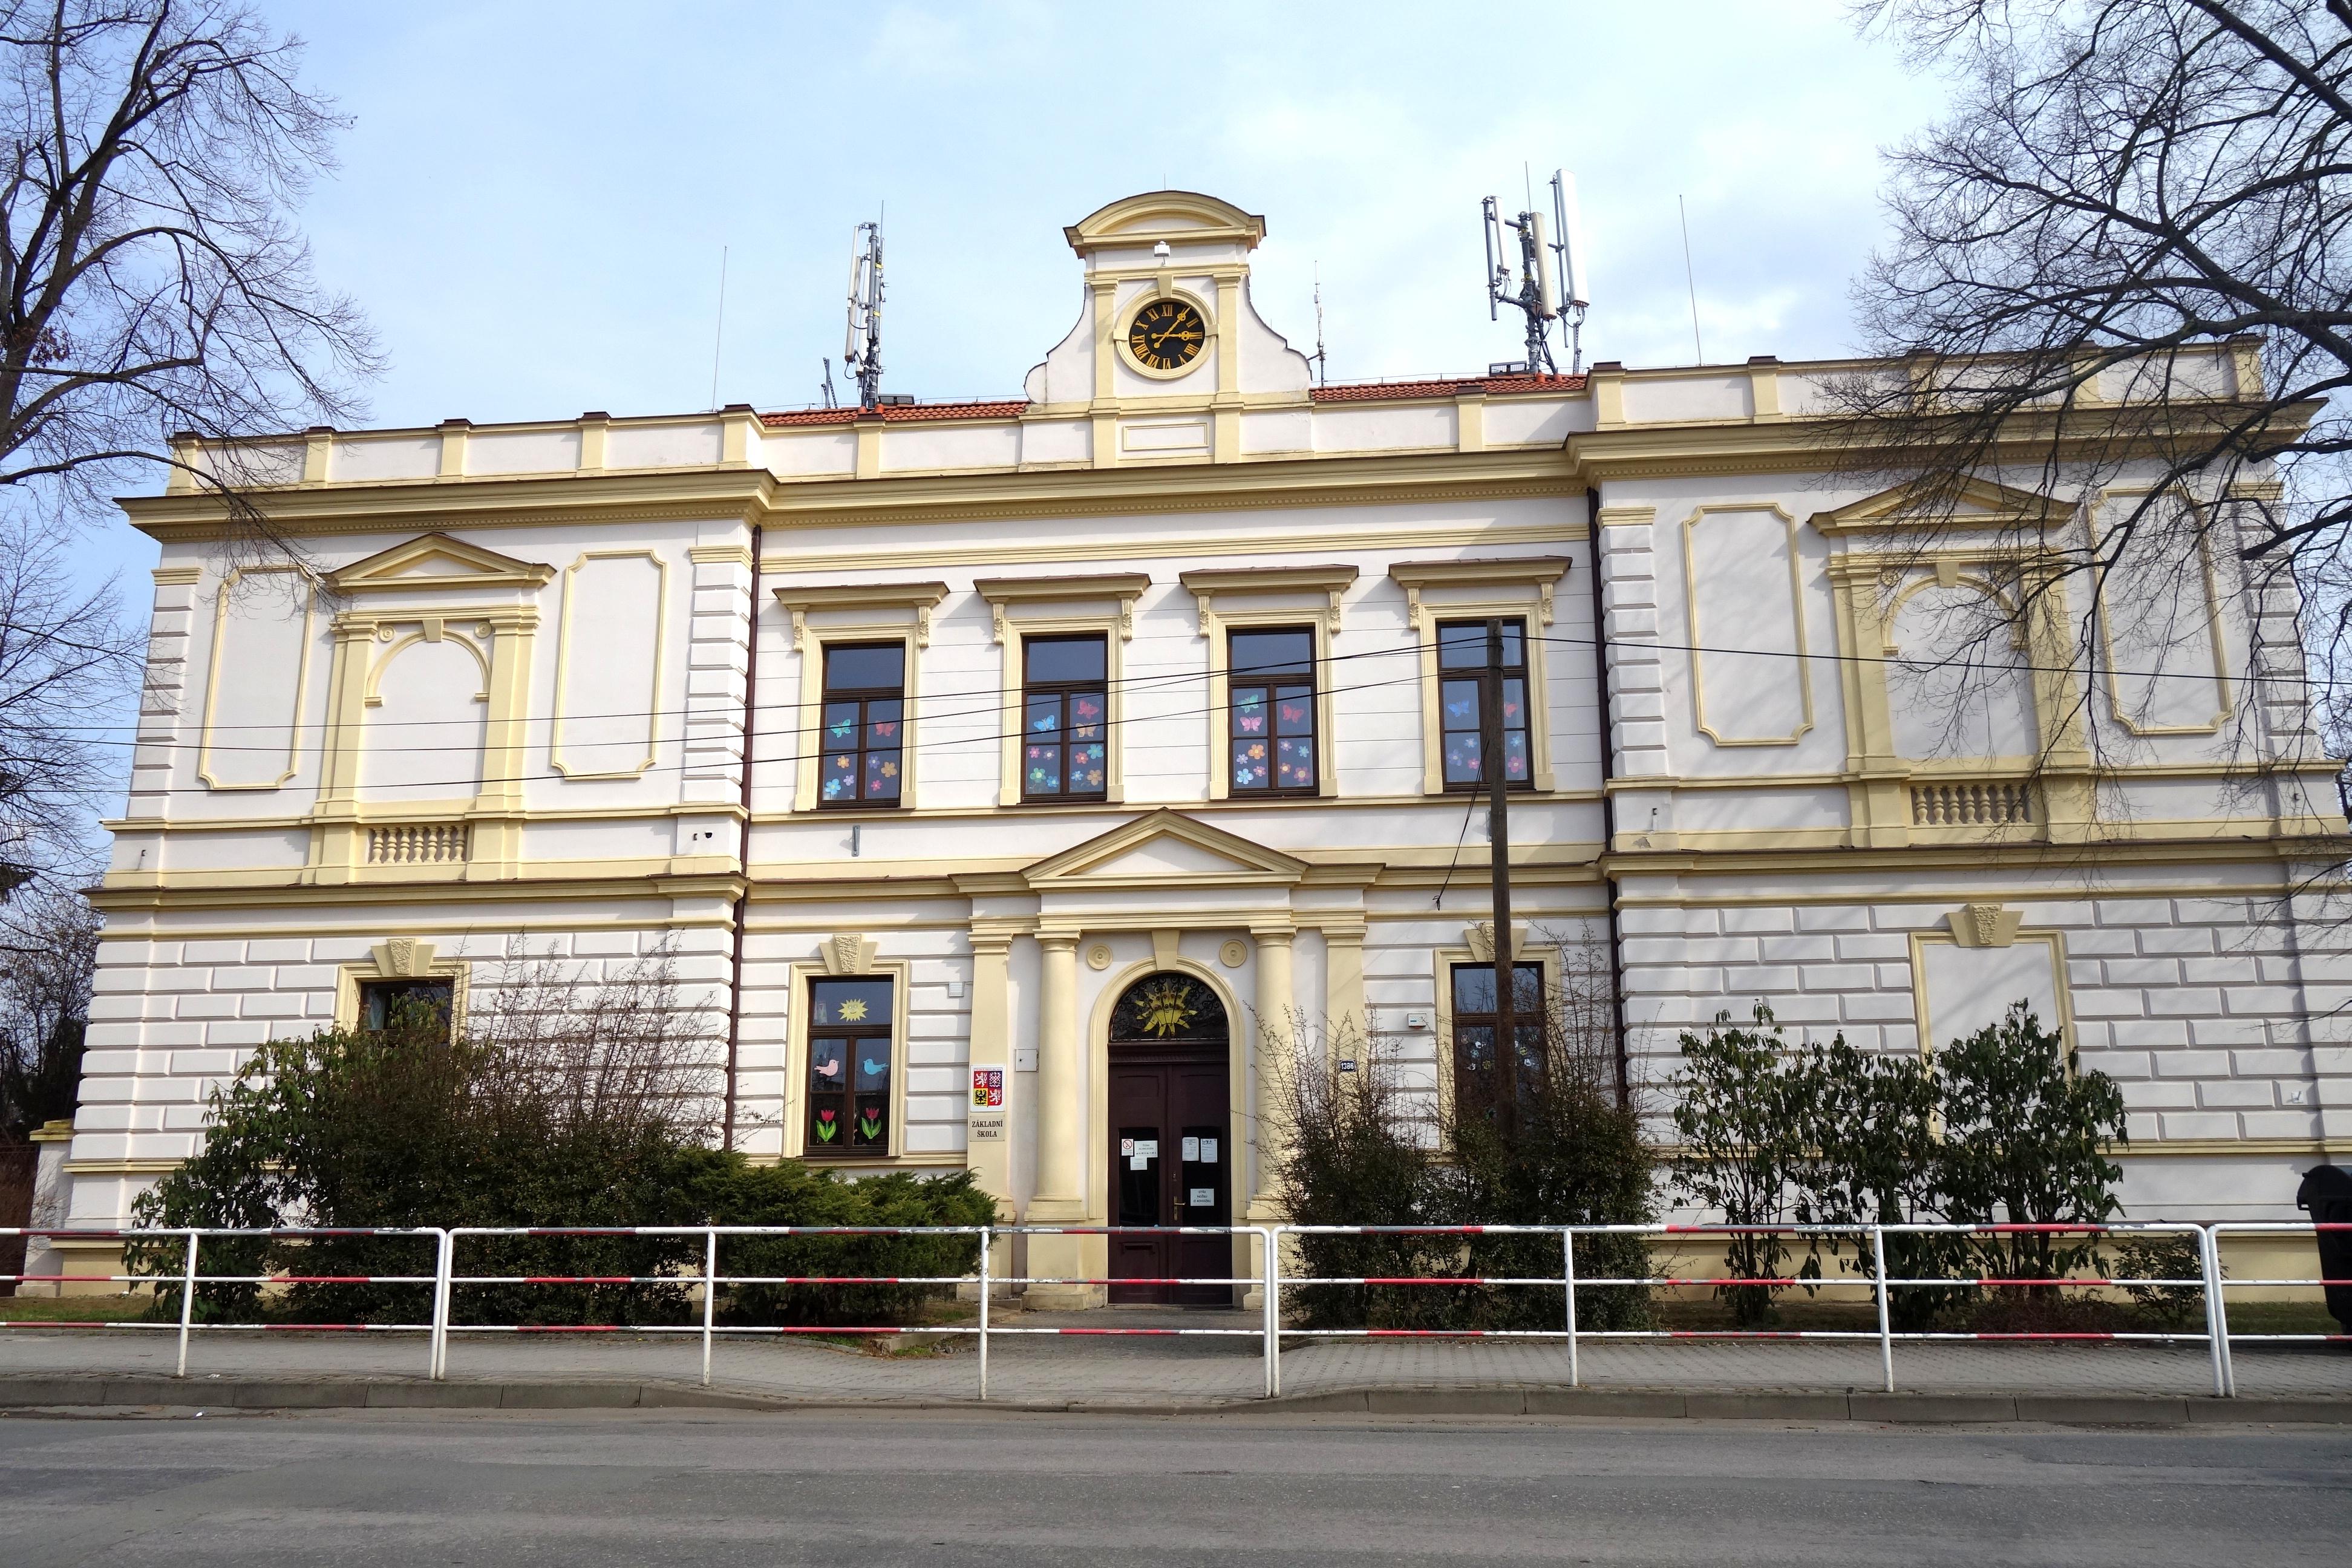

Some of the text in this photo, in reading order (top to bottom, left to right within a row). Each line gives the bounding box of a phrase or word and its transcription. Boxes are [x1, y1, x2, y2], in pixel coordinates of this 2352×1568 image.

[1146, 308, 1160, 322] XI
[1161, 304, 1173, 317] XII
[1135, 320, 1149, 330] X
[1186, 317, 1199, 328] II
[972, 1119, 1003, 1128] ZÁKLADNÍ
